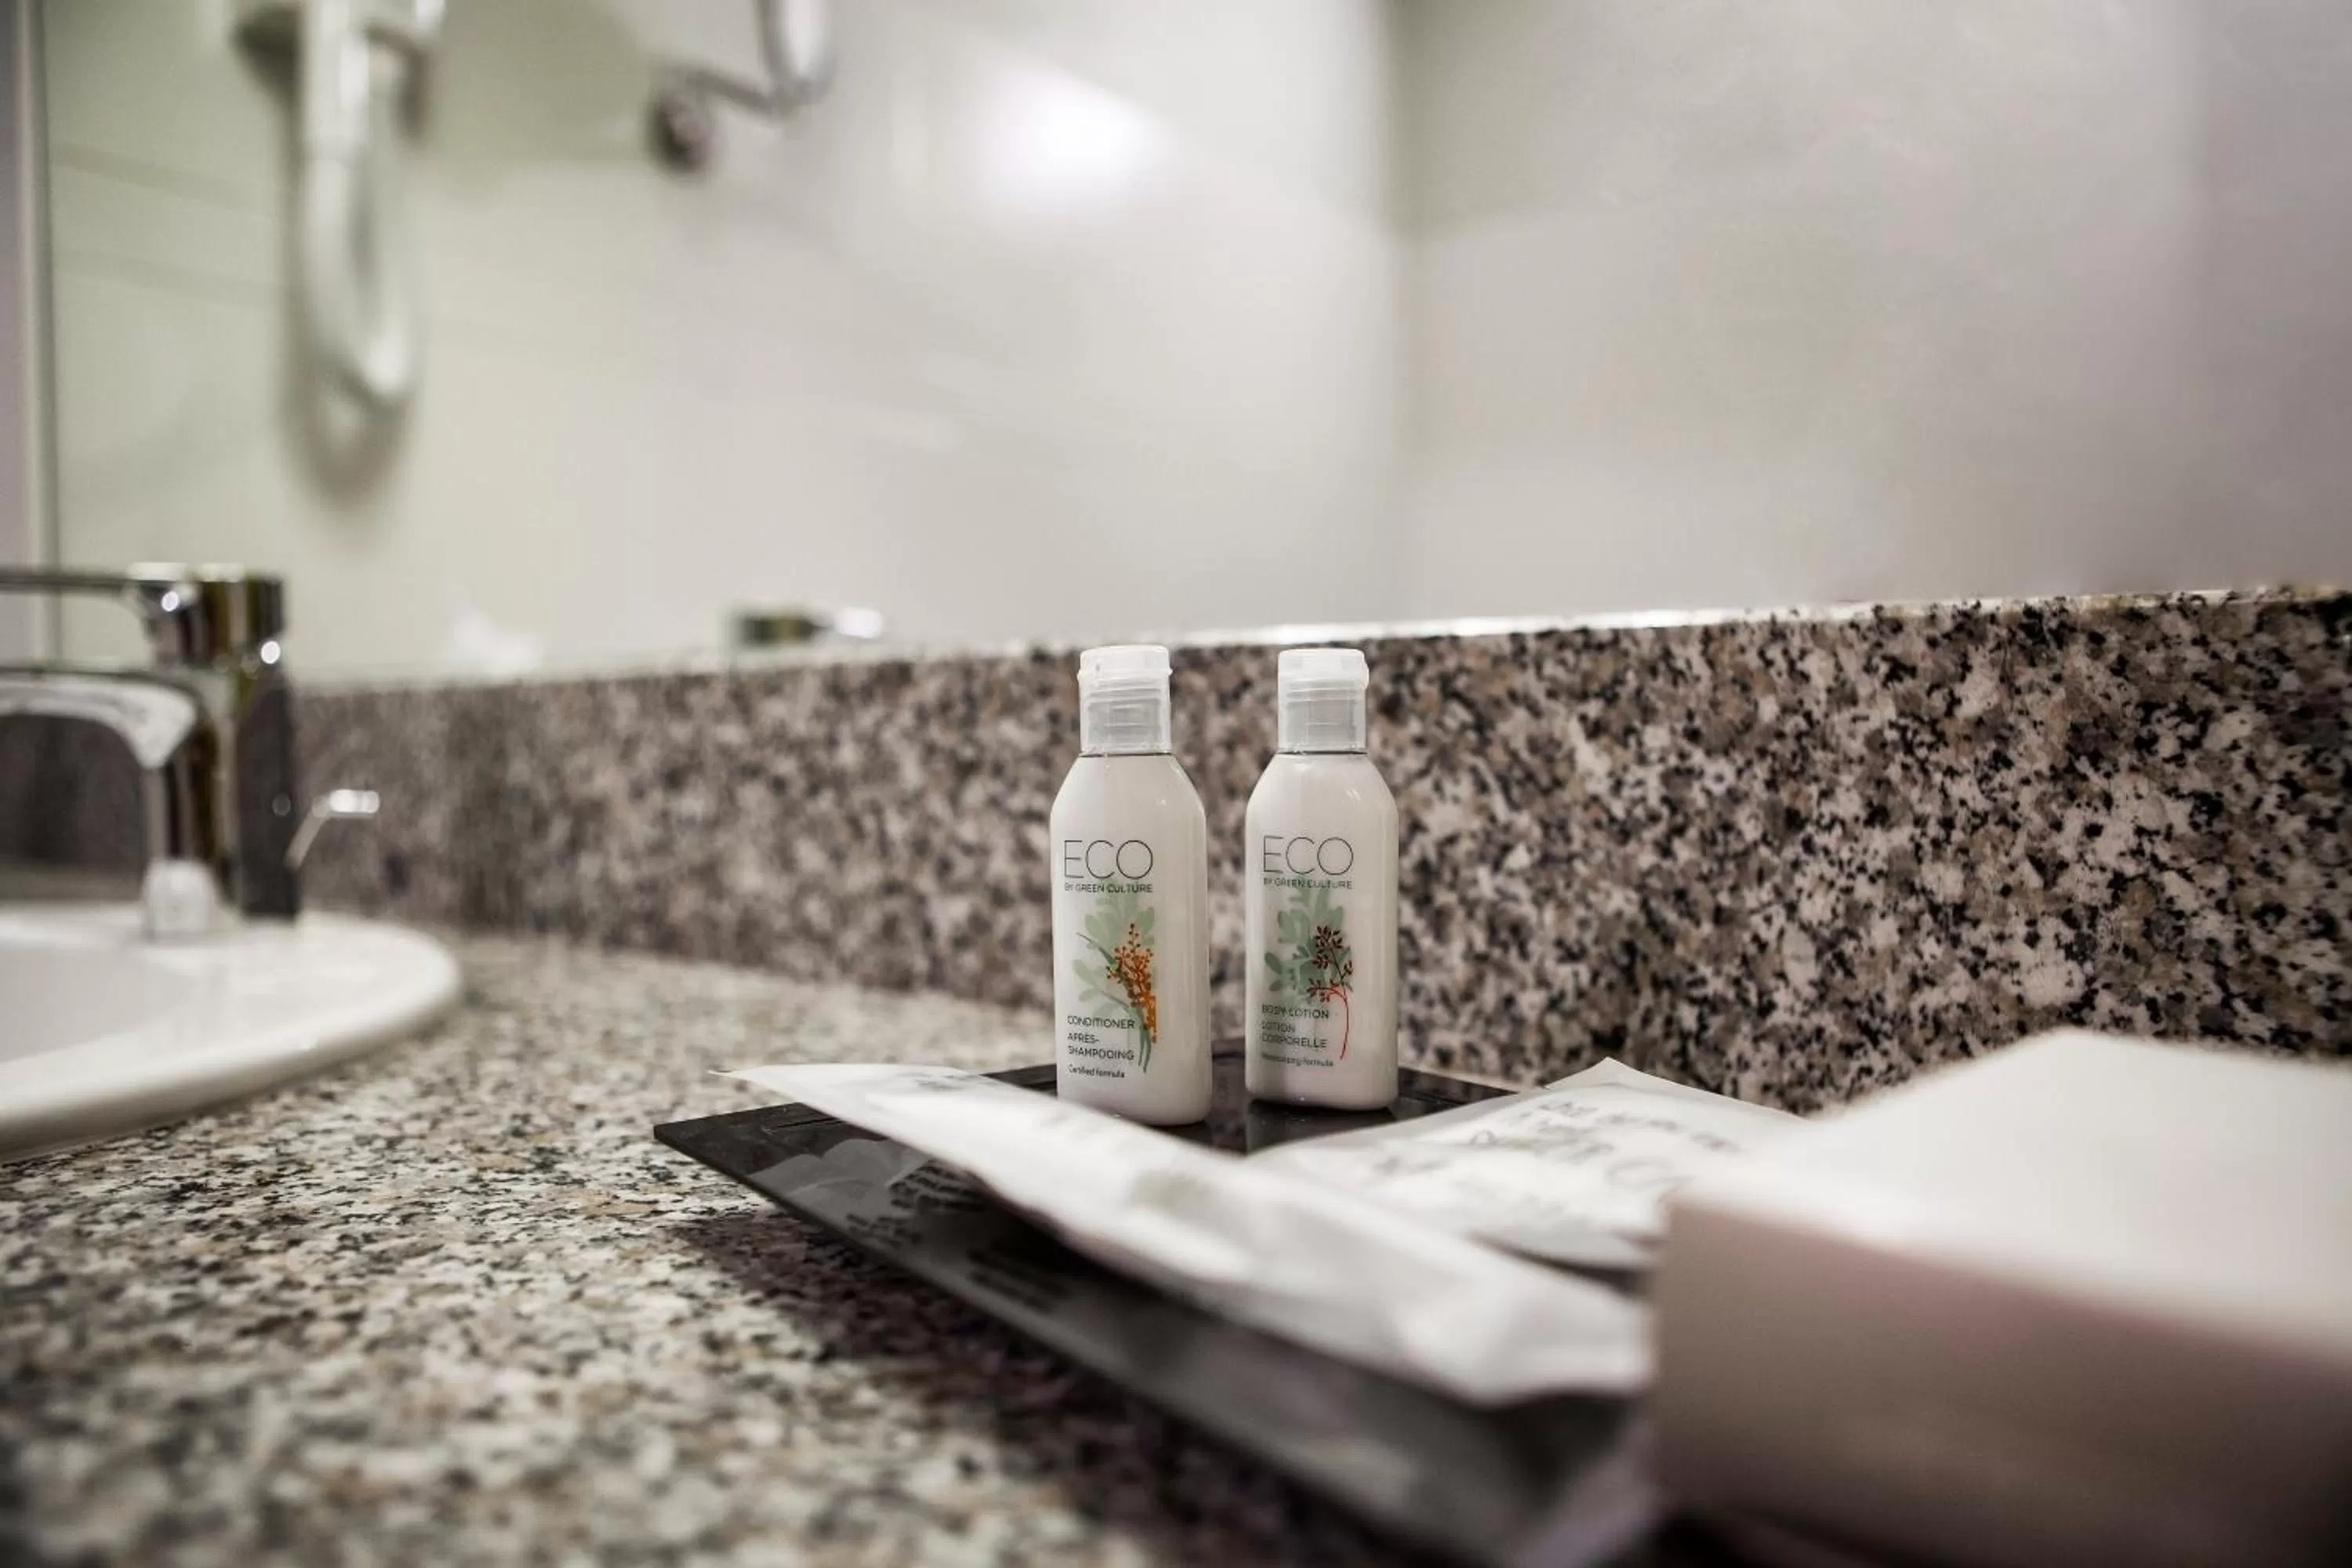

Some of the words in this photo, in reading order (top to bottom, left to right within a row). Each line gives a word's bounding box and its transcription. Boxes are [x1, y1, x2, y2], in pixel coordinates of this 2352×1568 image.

[1064, 840, 1153, 880] ECO
[1263, 835, 1354, 876] ECO
[1065, 883, 1074, 891] BY
[1075, 884, 1105, 893] GREEN
[1106, 884, 1153, 893] CULTURE
[1067, 1015, 1135, 1029] CONDITIONER
[1068, 1045, 1134, 1060] SHAMPOOING
